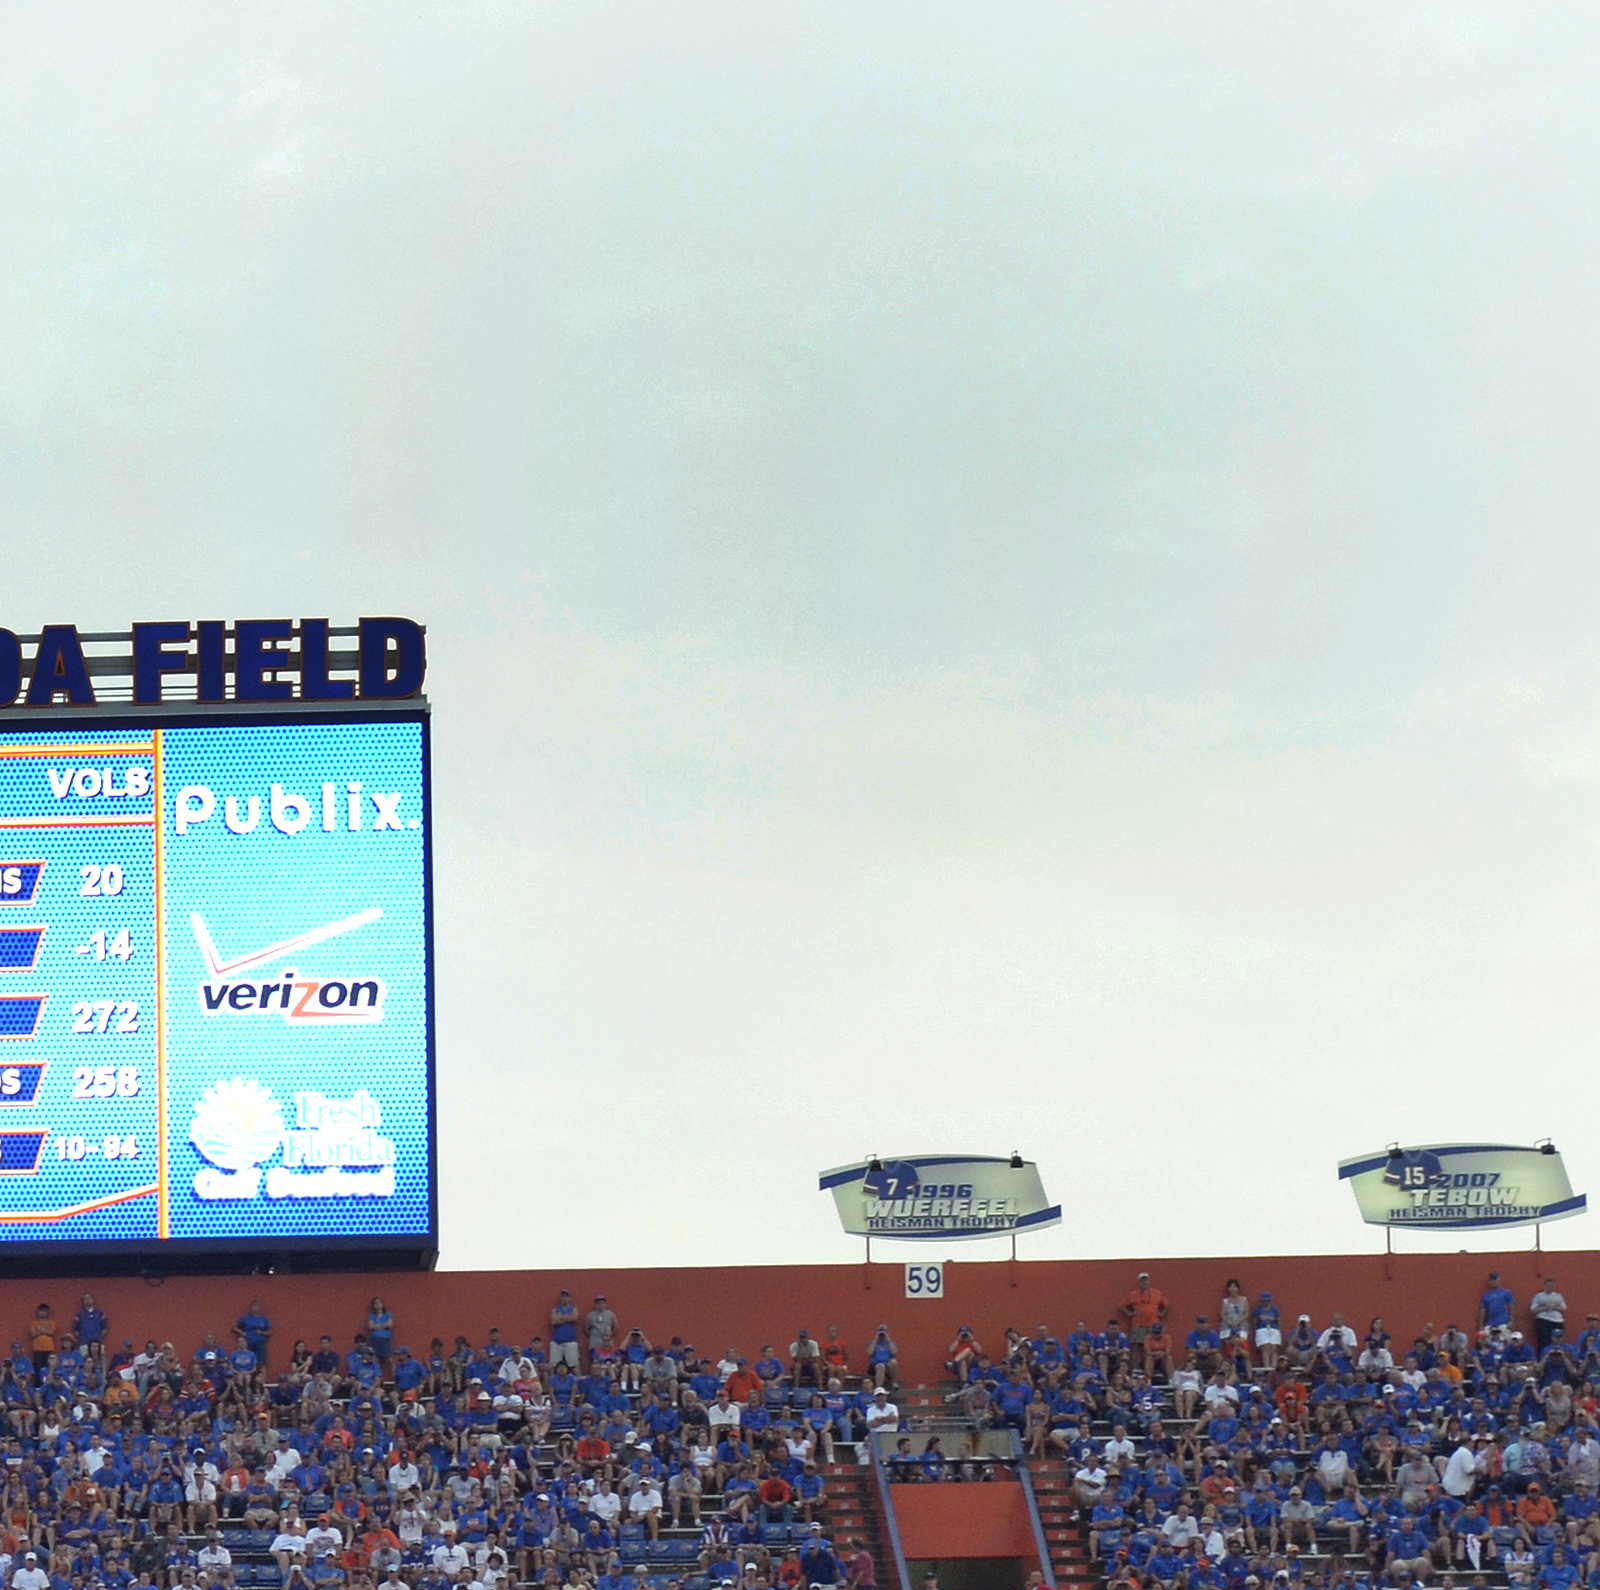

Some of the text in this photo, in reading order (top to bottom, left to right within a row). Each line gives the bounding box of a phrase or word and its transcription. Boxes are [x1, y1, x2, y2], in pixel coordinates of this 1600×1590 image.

[131, 616, 428, 705] FIELD
[47, 766, 151, 799] VOLS
[78, 864, 125, 897] 20
[75, 930, 135, 963] -14
[202, 971, 380, 1018] verizon
[70, 999, 140, 1035] 272
[70, 1065, 140, 1100] 258
[886, 1178, 899, 1196] 7
[1403, 1166, 1426, 1186] 15
[1435, 1172, 1502, 1188] 2007
[912, 1183, 974, 1199] 1996
[1410, 1187, 1521, 1208] TEBOW
[865, 1199, 1019, 1219] WUERFFEL
[1389, 1205, 1542, 1219] HEISMAN TROPHY
[869, 1216, 1018, 1229] HEISMAN TROPHY
[906, 1266, 942, 1295] 59
